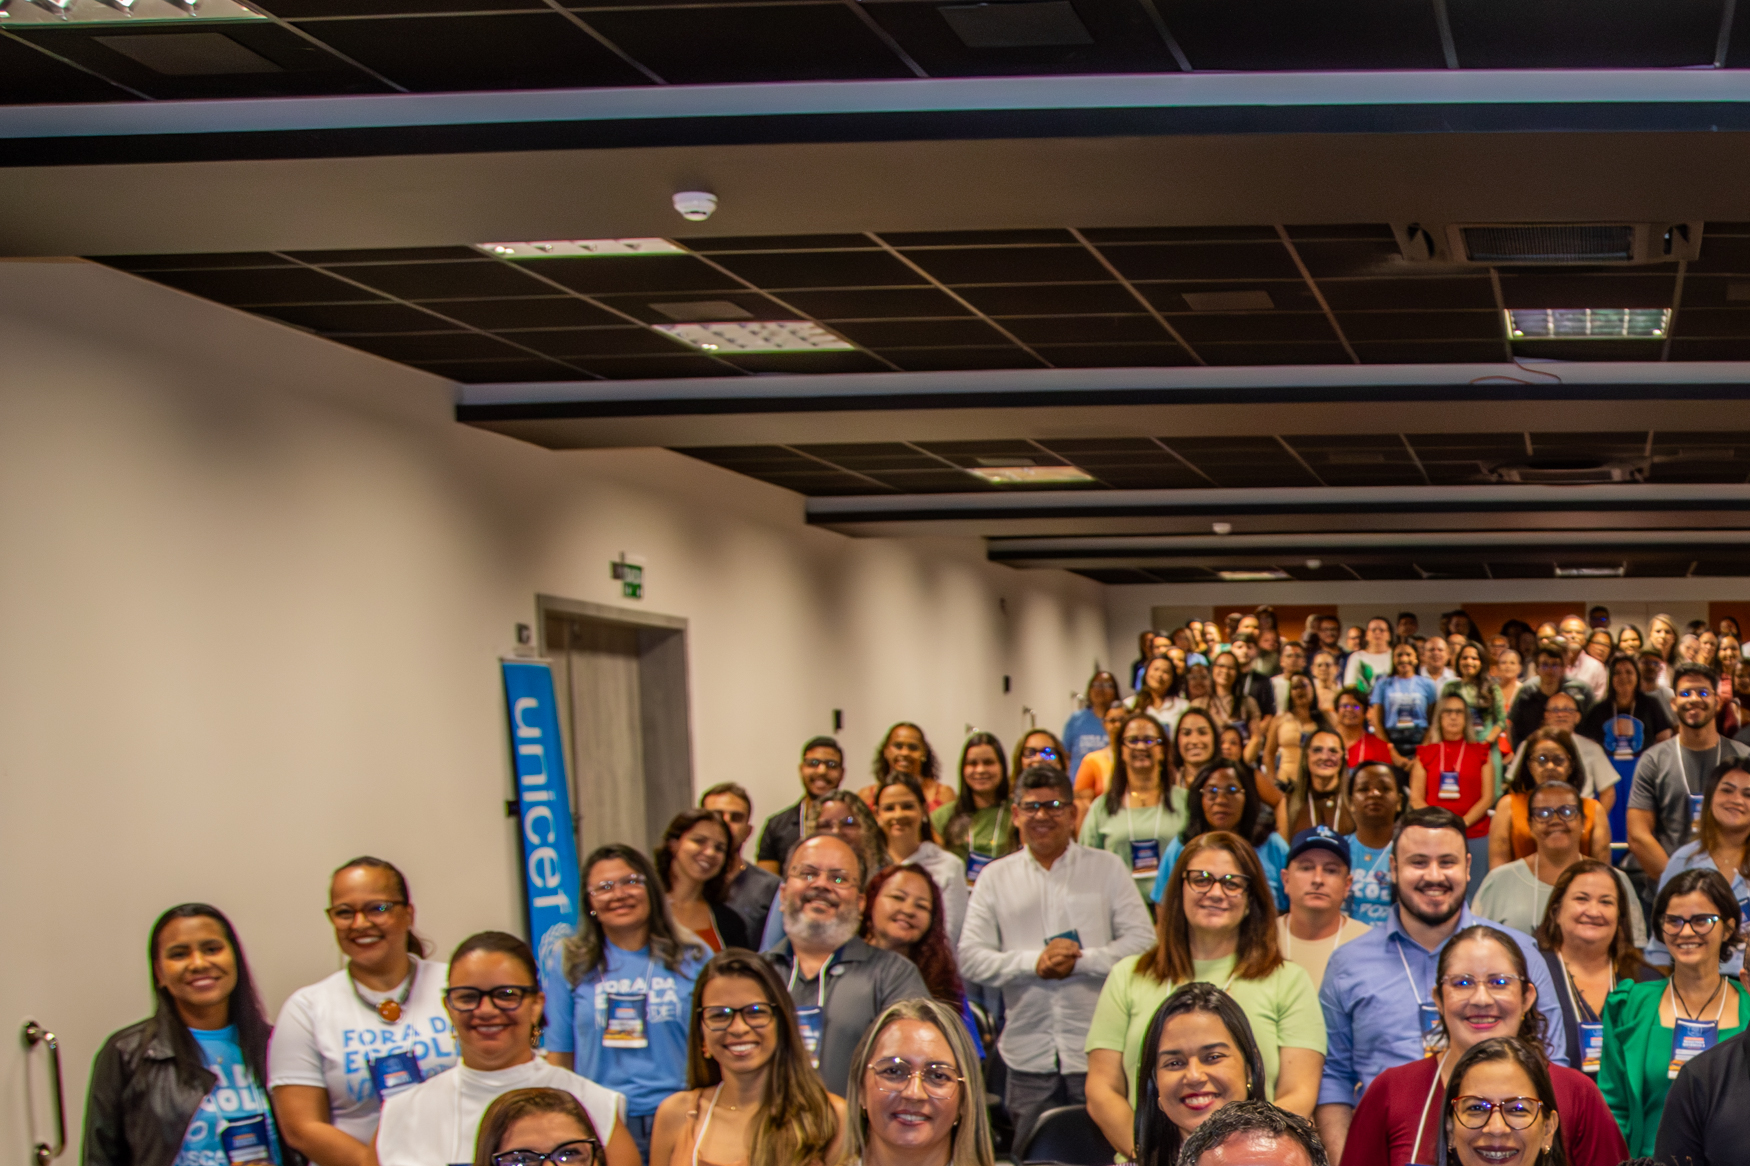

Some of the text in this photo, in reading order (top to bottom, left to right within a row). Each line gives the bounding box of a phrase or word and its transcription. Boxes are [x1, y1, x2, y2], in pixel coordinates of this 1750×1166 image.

[514, 697, 571, 914] unicef
[594, 977, 648, 994] FORA
[343, 1024, 420, 1048] FORA
